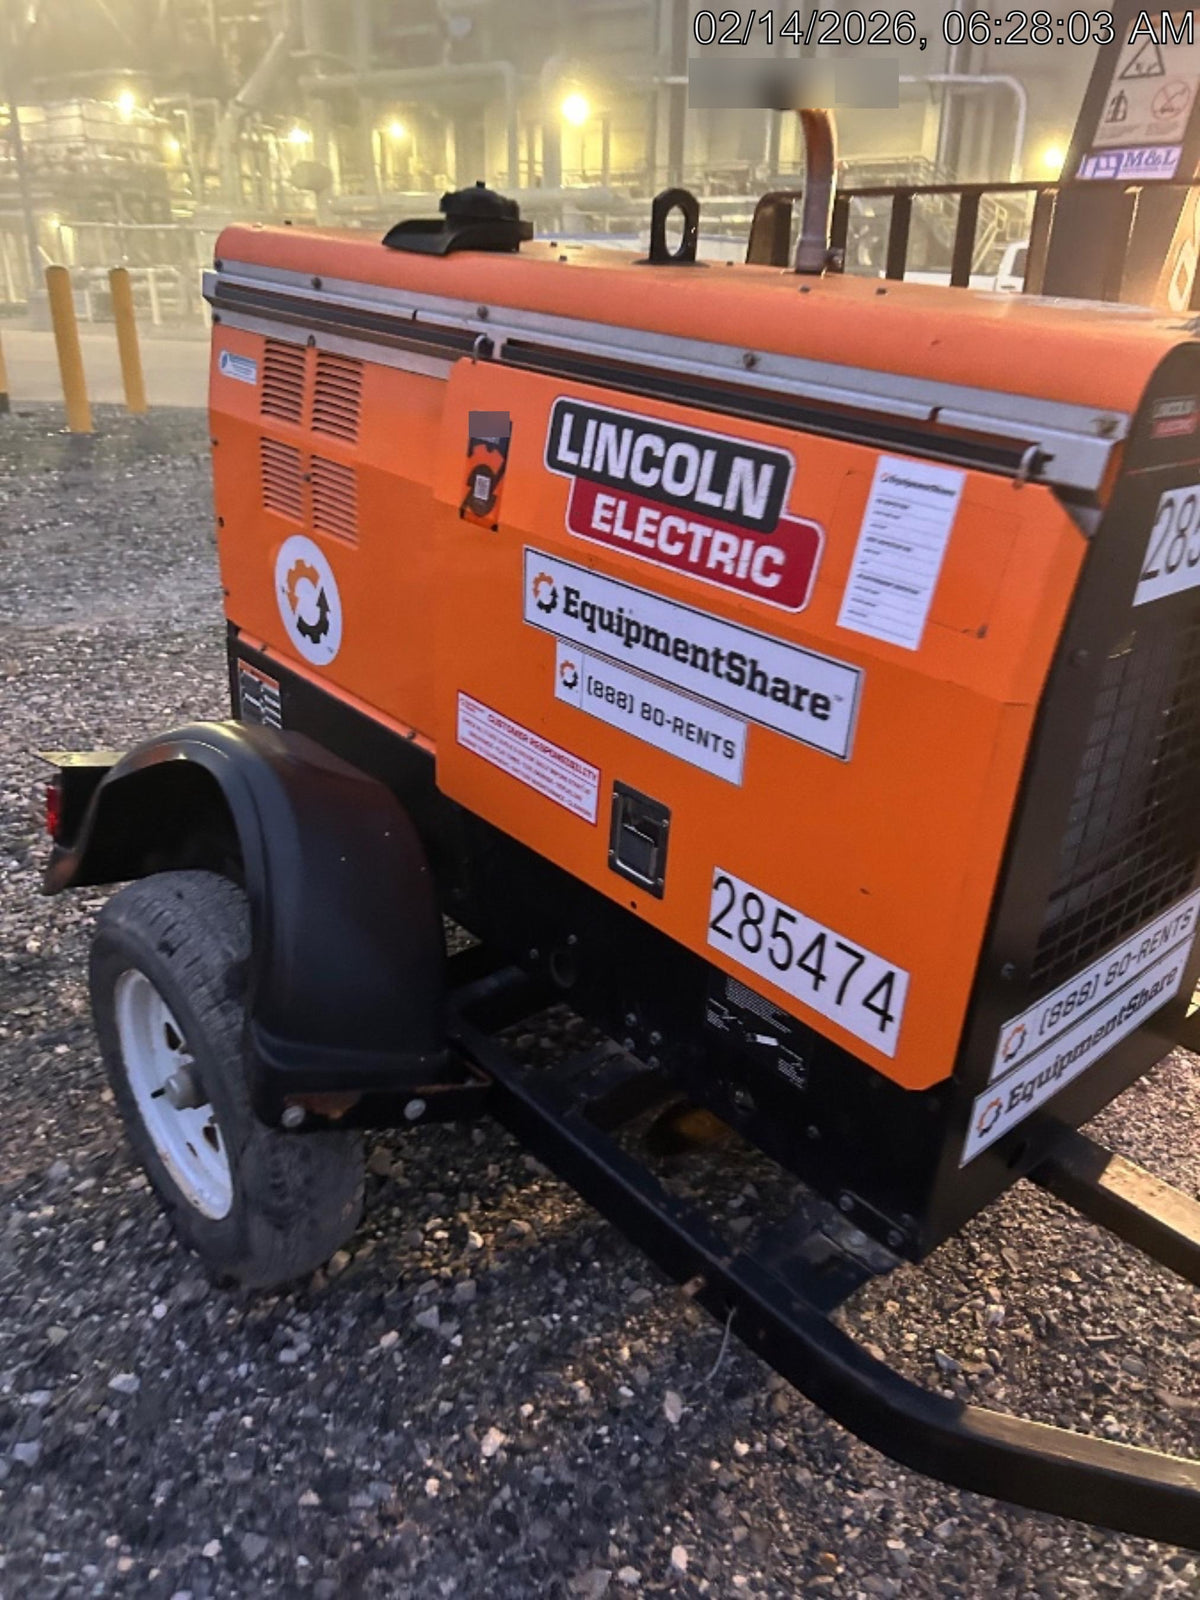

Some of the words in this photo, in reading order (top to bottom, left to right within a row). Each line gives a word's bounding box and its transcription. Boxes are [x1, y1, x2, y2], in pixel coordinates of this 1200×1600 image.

[557, 412, 776, 519] LINCOLN
[591, 493, 785, 588] ELECTRIC
[563, 586, 832, 721] EquipmentShare
[640, 702, 736, 759] 80-RENTS
[709, 876, 896, 1033] 285474
[1103, 906, 1194, 988] 80-RENTS
[1005, 966, 1178, 1114] EquipmentShare
